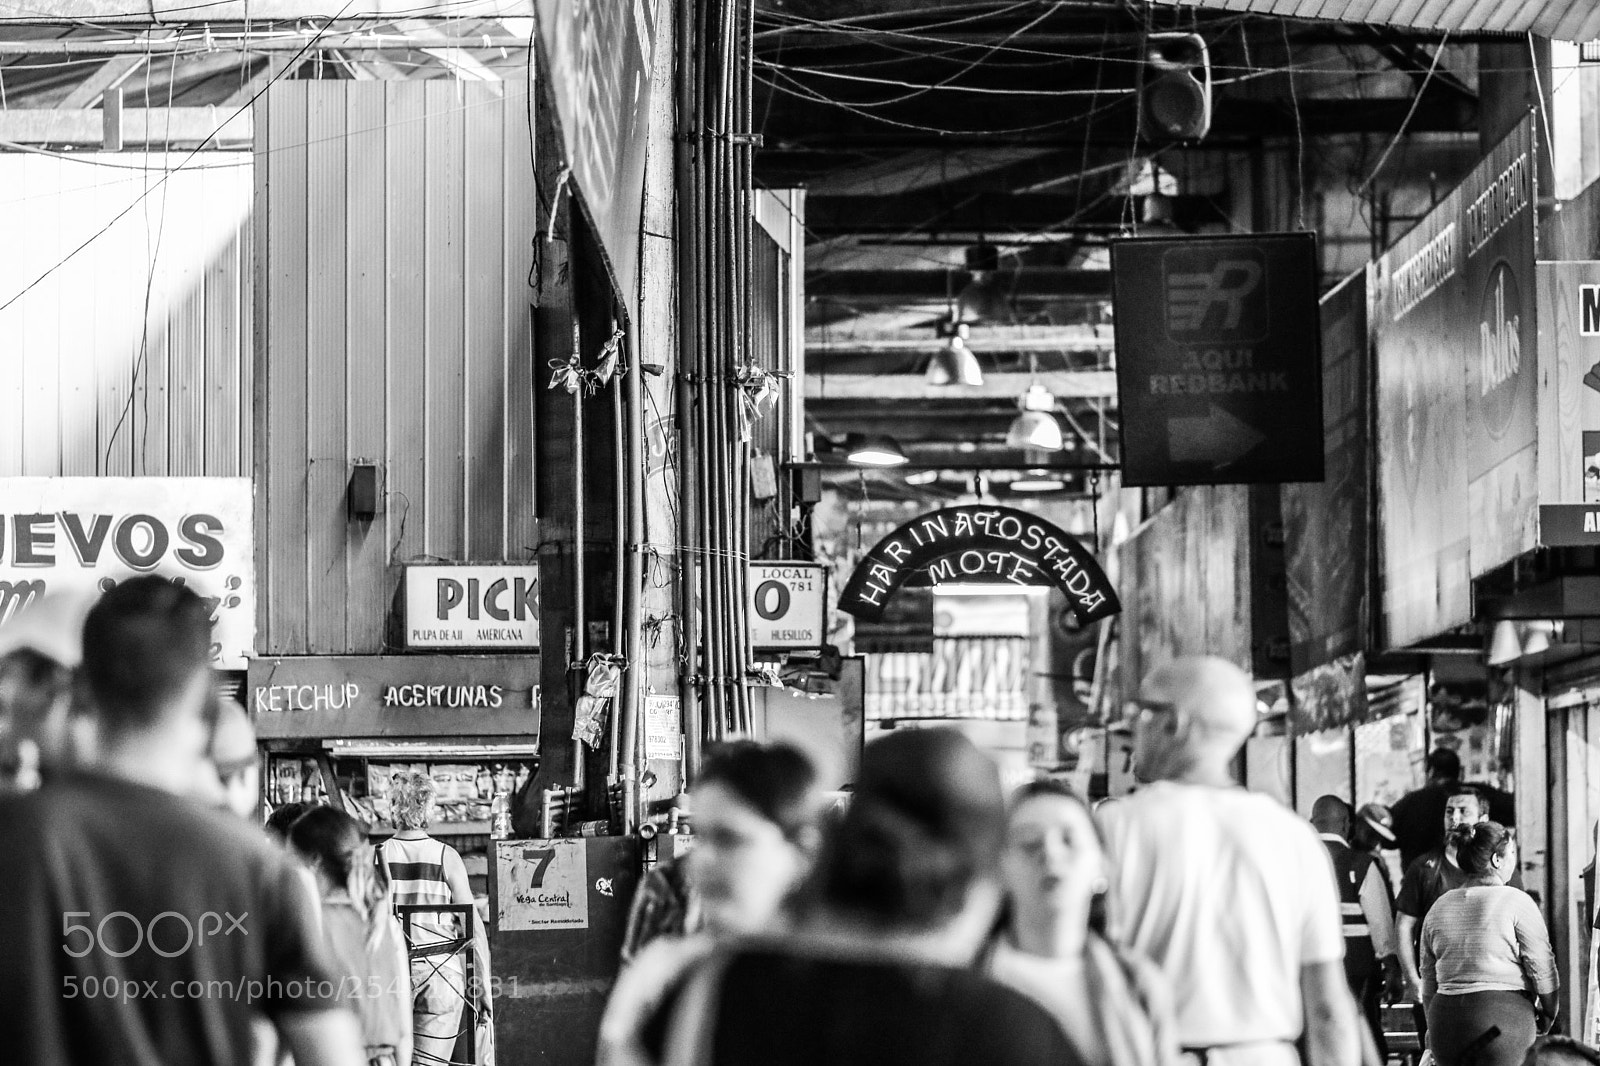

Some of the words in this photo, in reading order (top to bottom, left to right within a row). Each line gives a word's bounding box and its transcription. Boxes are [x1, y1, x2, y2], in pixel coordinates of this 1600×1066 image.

[1149, 373, 1289, 395] REDBANK
[0, 512, 225, 571] EVOS
[762, 569, 813, 579] LOCAL
[928, 550, 1038, 586] MOTE
[790, 582, 812, 591] 781
[413, 629, 437, 640] PULPA
[440, 629, 449, 640] DE
[477, 629, 523, 640] AMERICANA
[771, 629, 813, 640] HUESILLOS
[256, 682, 359, 712] KETCHUP
[384, 684, 503, 708] ACEITUNAS
[523, 849, 555, 888] 7
[516, 894, 536, 904] Vega
[538, 891, 571, 908] Central
